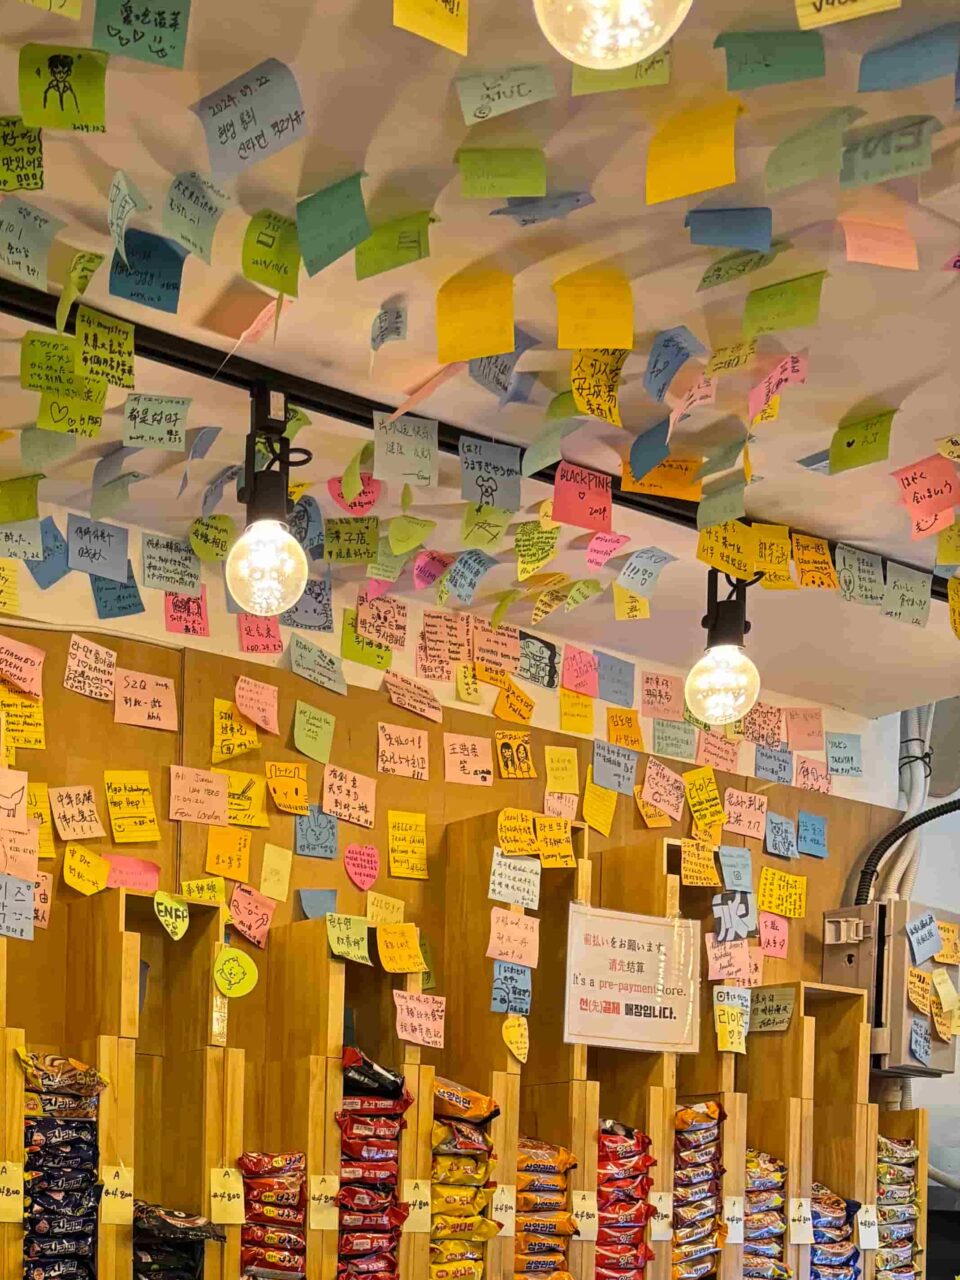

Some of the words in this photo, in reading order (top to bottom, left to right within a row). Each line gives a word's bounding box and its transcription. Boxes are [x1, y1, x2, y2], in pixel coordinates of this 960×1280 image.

[156, 901, 189, 922] ENFP
[573, 973, 586, 986] It's
[589, 979, 595, 987] a
[0, 1166, 7, 1176] A
[113, 1170, 120, 1180] A
[223, 1170, 230, 1180] A
